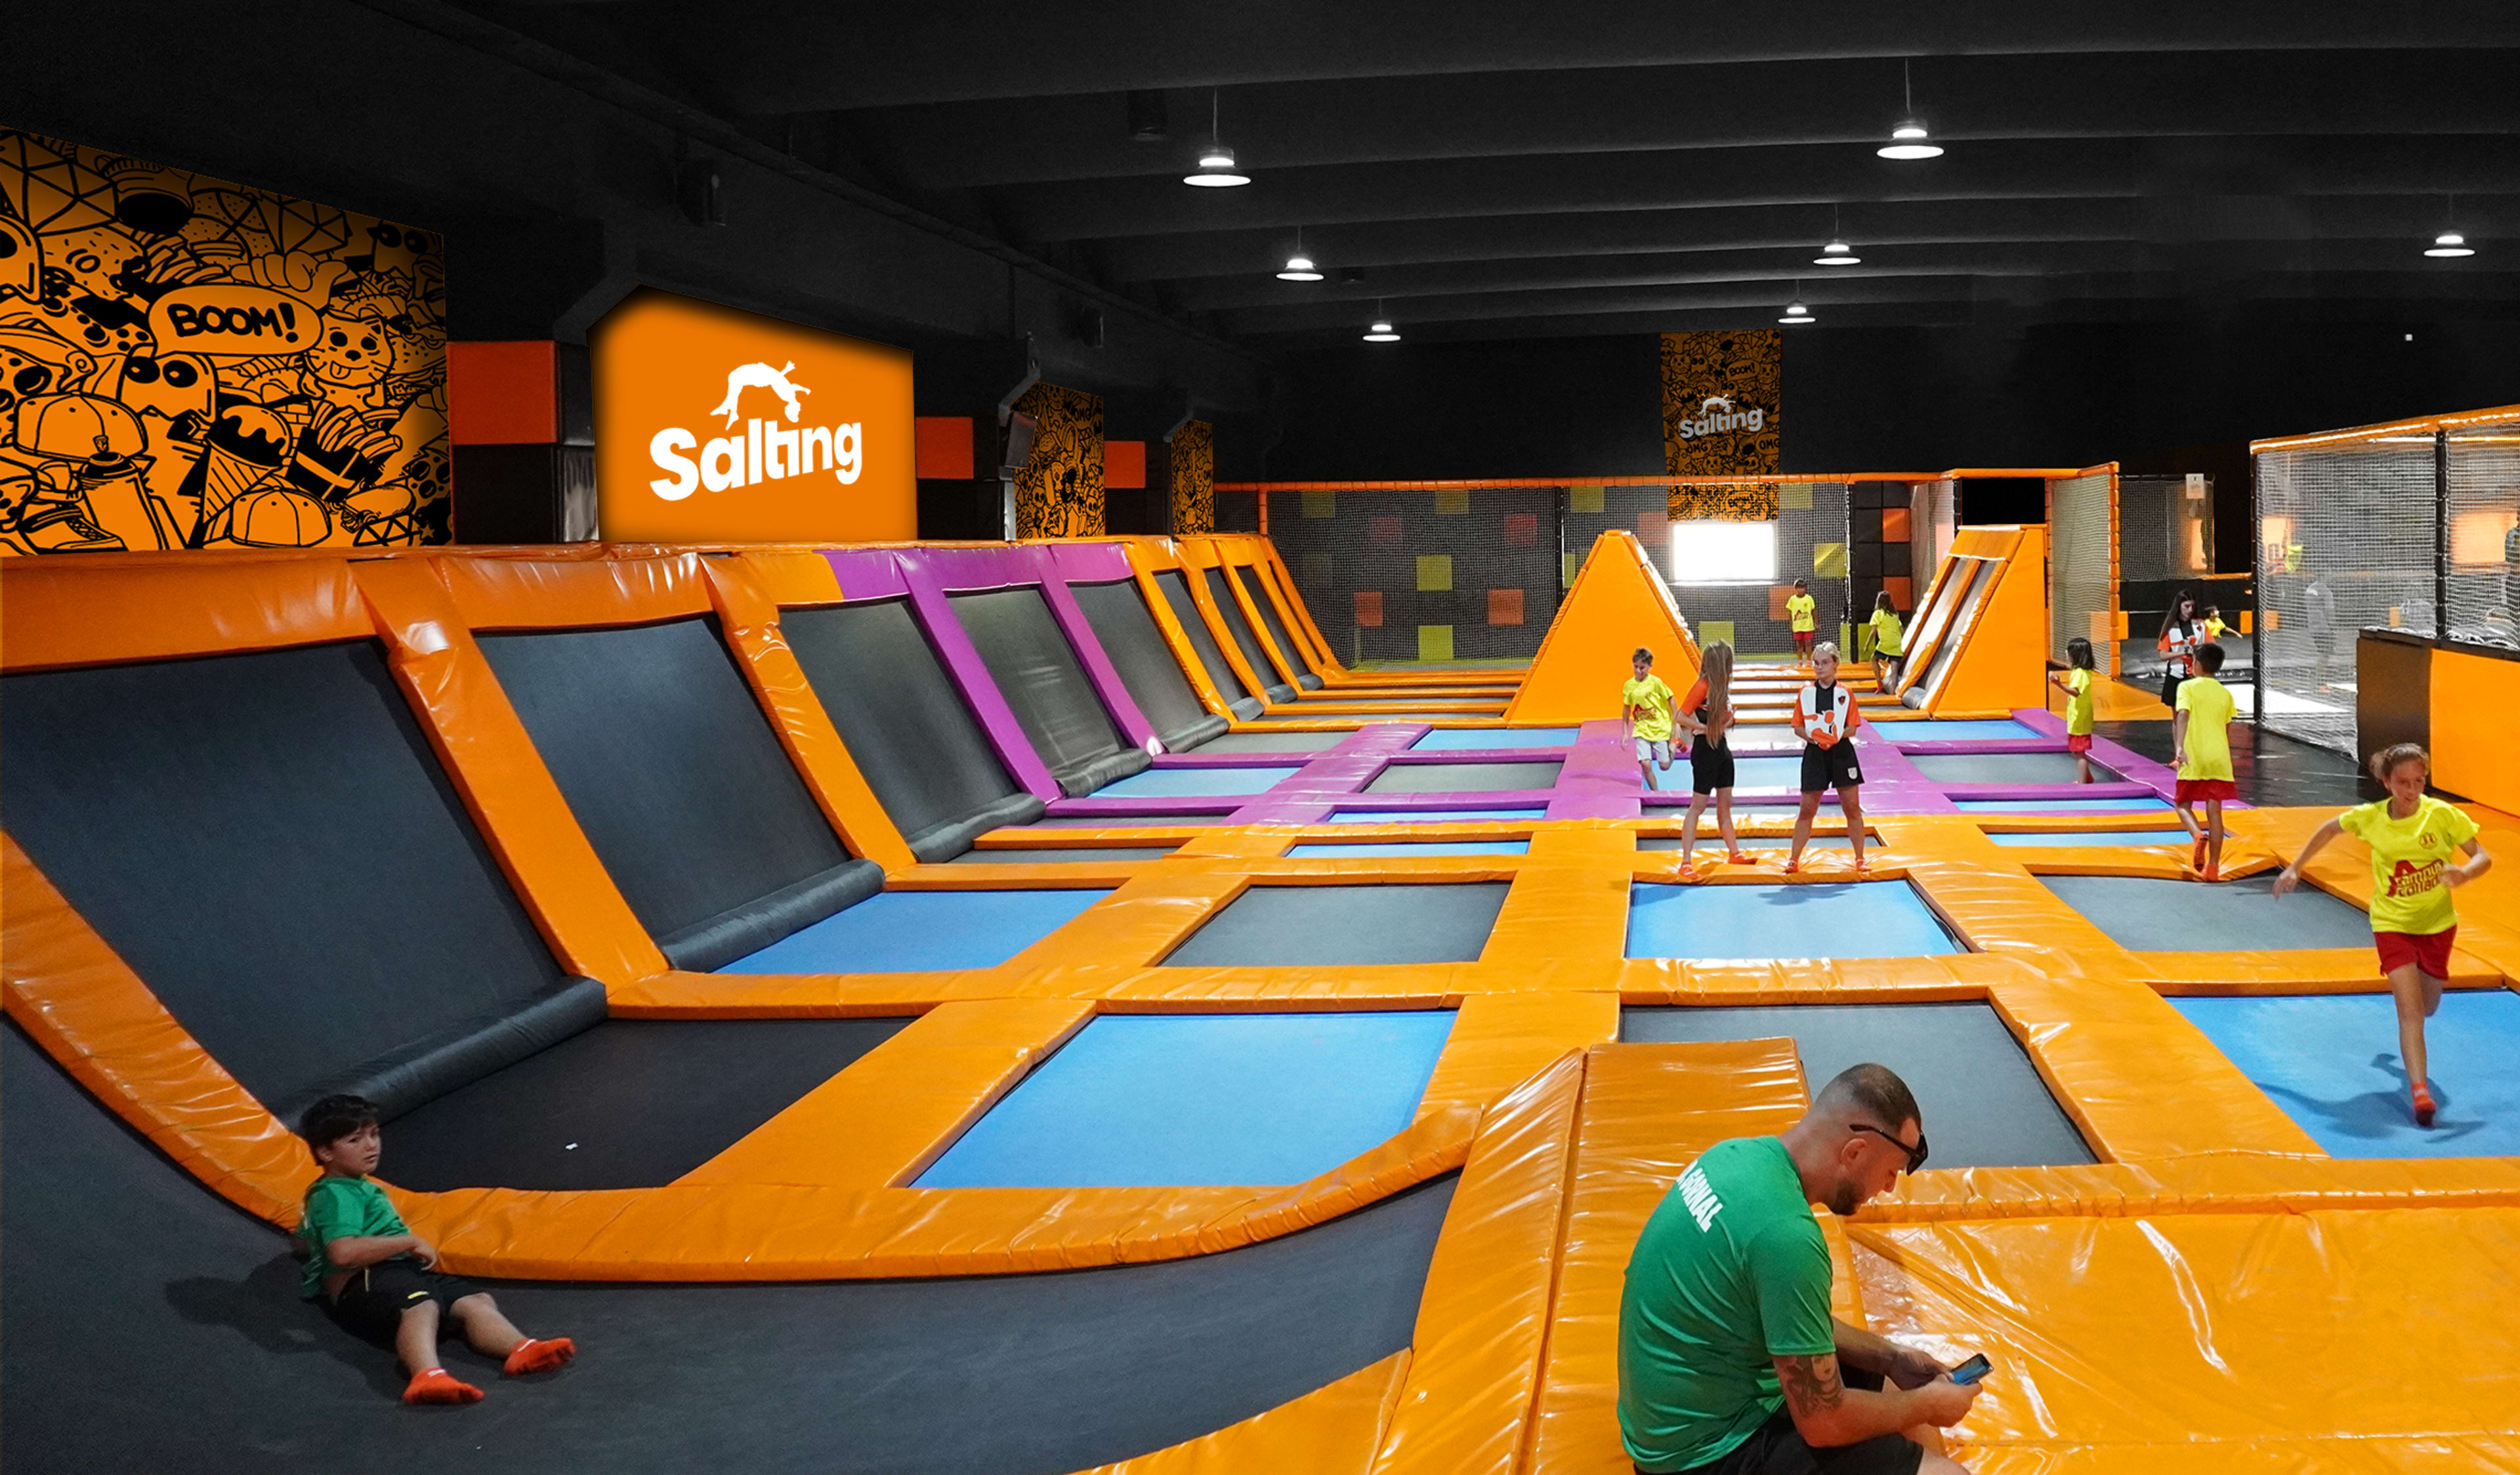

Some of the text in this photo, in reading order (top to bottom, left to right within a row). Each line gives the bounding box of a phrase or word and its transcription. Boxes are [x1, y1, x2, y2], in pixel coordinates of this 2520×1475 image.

[167, 302, 299, 343] BOOM!
[1729, 362, 1755, 377] BOOM!
[1679, 408, 1763, 438] Salting
[650, 417, 862, 501] Salting
[1759, 438, 1780, 450] OMG
